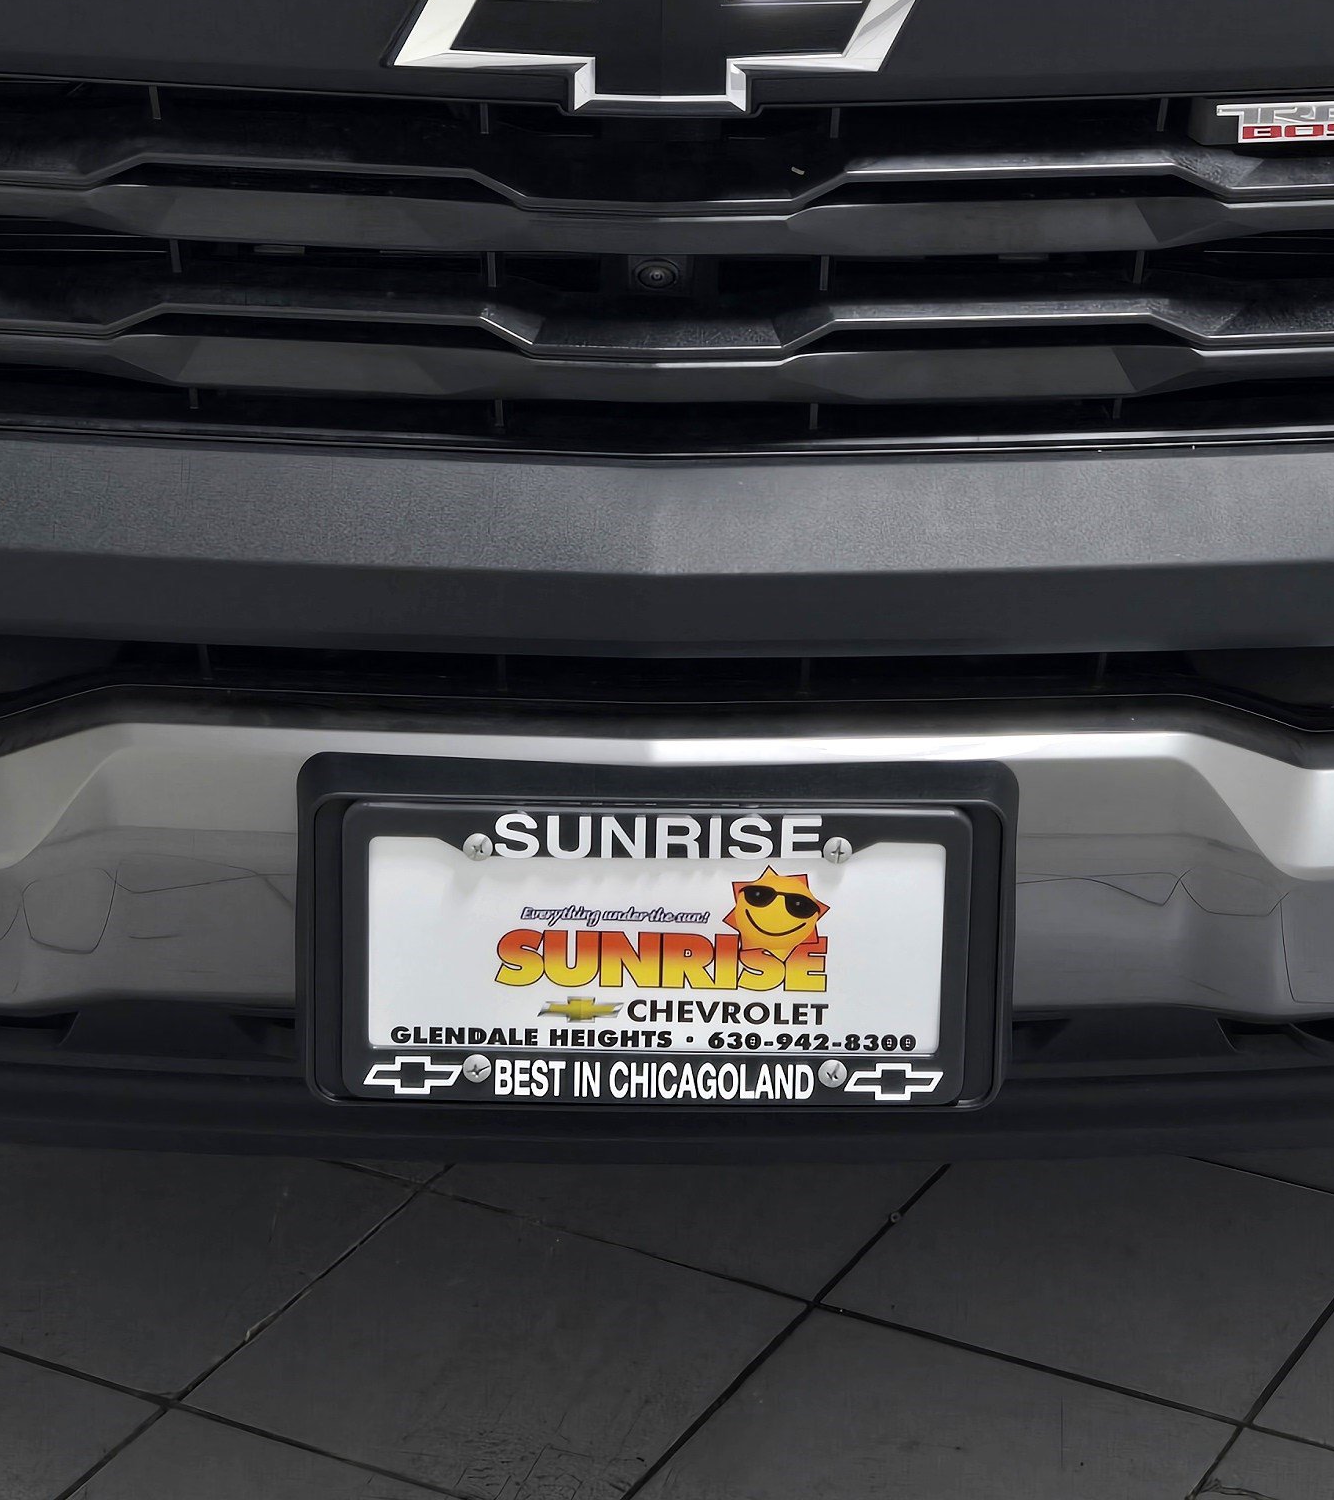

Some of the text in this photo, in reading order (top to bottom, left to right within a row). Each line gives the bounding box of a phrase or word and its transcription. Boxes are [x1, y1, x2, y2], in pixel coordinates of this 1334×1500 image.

[494, 813, 824, 860] SUNRISE
[520, 905, 601, 927] Everything
[602, 906, 649, 922] under
[647, 907, 675, 923] the
[494, 928, 829, 993] SUNRISE
[627, 999, 829, 1026] CHEVROLET
[390, 1026, 917, 1053] GLENDALE HEIGHTS 630-942-8300
[494, 1058, 815, 1100] BEST IN CHICAGOLAND
